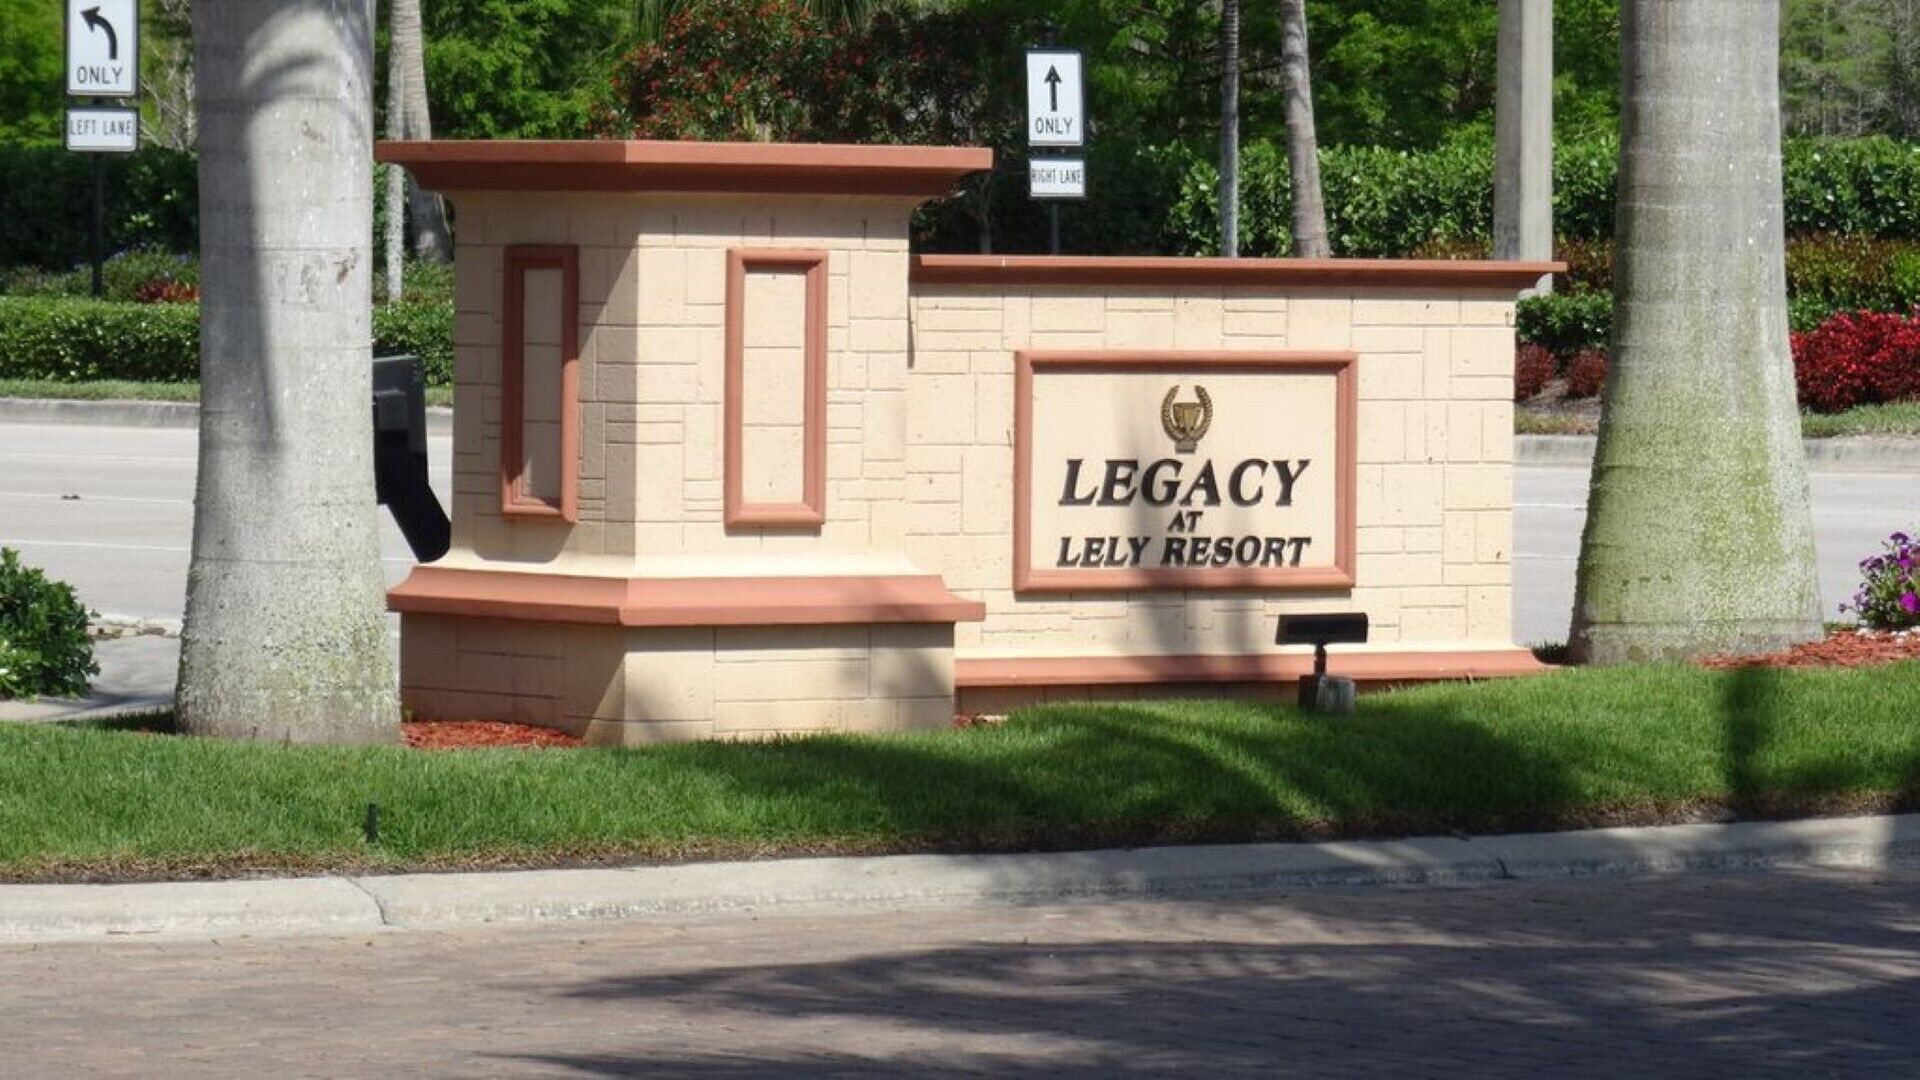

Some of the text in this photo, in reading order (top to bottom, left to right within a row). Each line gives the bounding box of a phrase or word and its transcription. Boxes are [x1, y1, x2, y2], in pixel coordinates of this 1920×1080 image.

[77, 66, 122, 84] ONLY
[70, 119, 132, 136] LEFT LANE
[1035, 117, 1073, 135] ONLY
[1032, 168, 1082, 184] RIGHT LANE
[1058, 458, 1311, 507] LEGACY
[1167, 510, 1203, 532] AT
[1057, 535, 1312, 567] LELY RESORT
